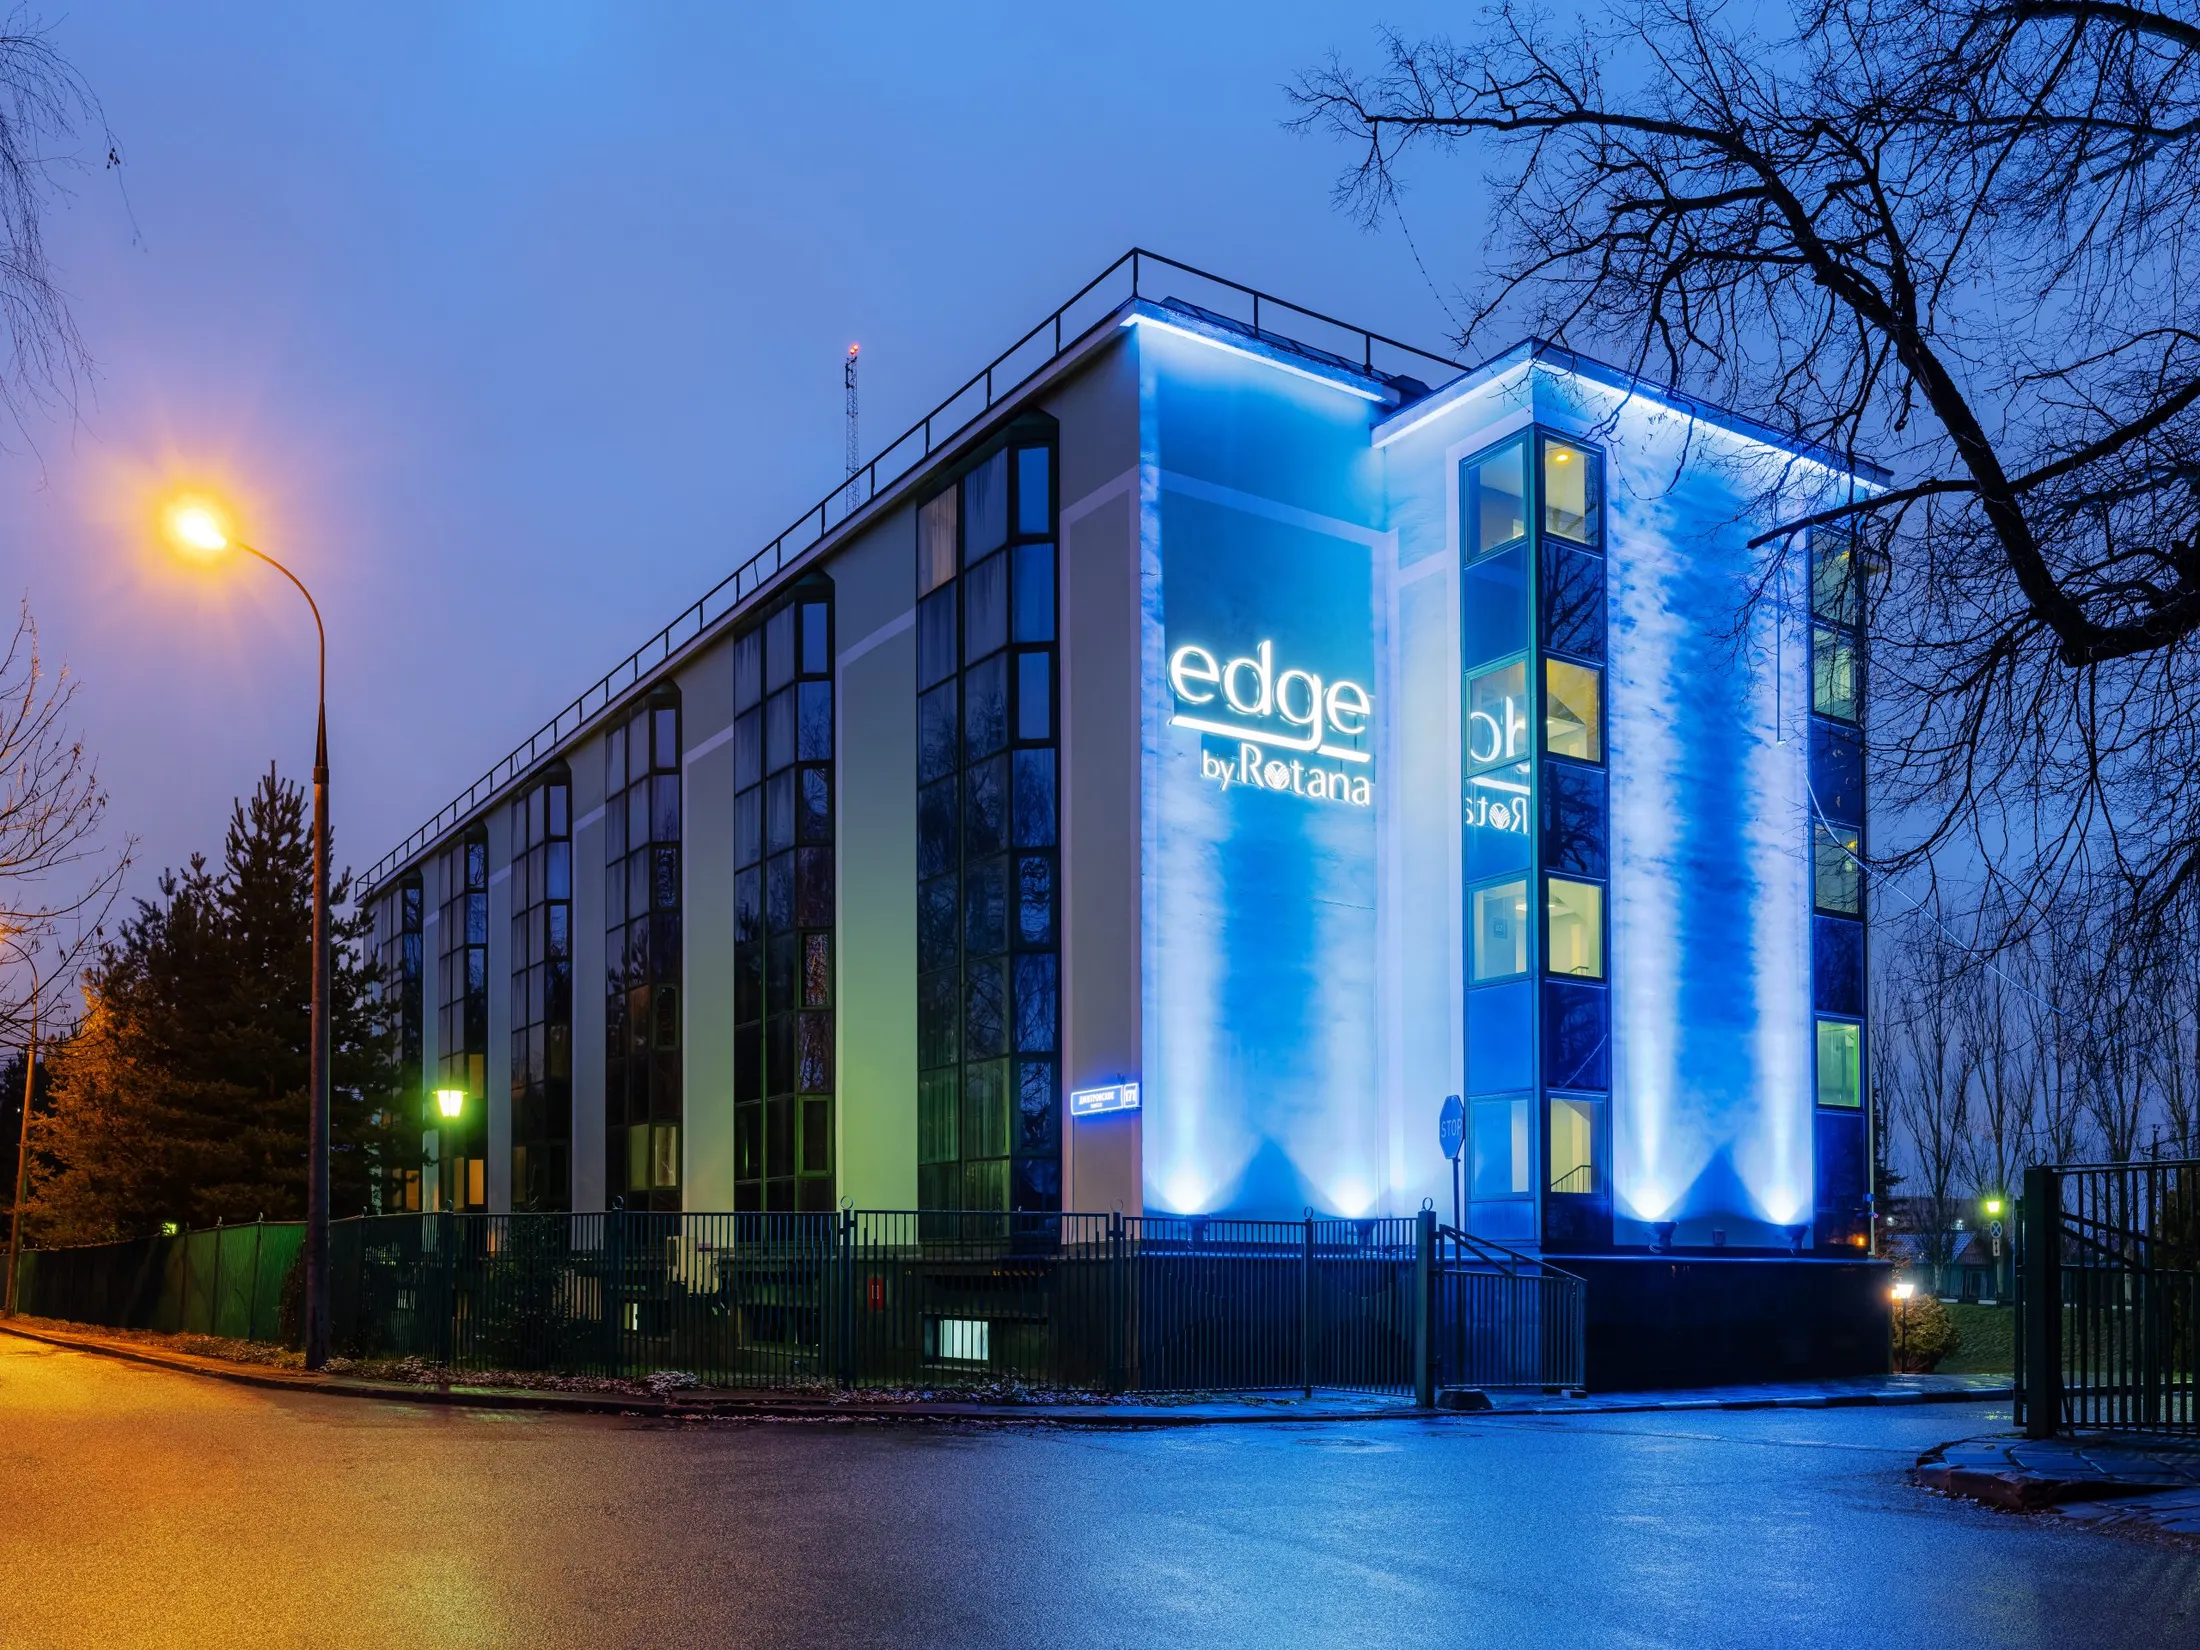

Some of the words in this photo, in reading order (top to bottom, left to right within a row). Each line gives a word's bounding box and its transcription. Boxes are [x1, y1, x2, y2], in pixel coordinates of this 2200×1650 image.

[1169, 640, 1371, 752] edge
[1202, 749, 1236, 791] by
[1241, 742, 1371, 806] Rotana
[1441, 1118, 1463, 1138] STOP
